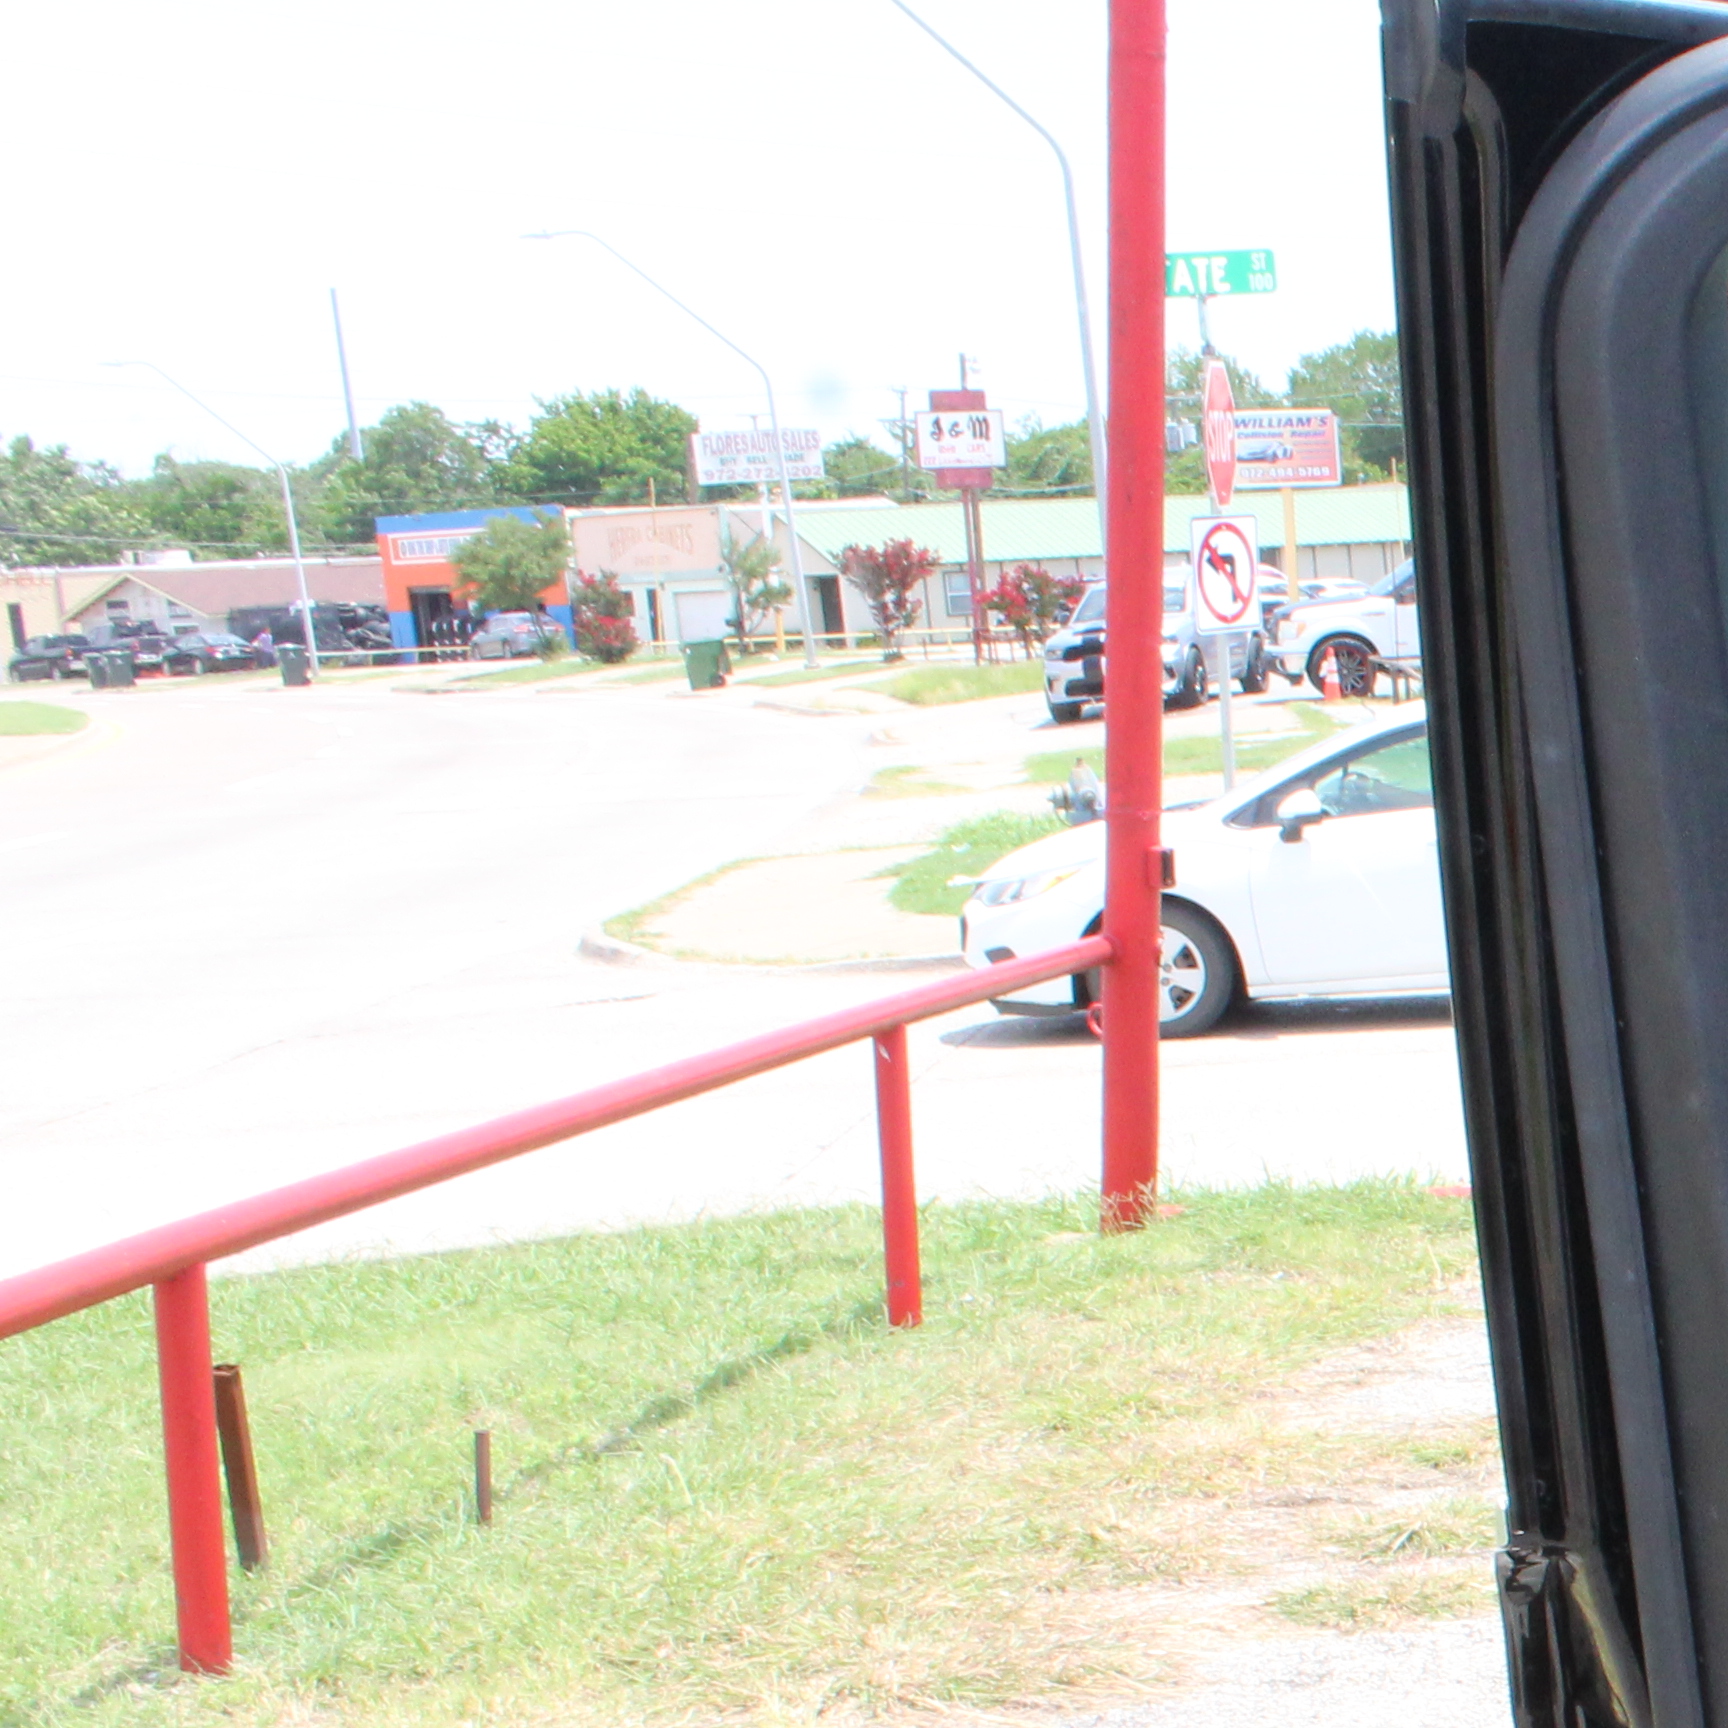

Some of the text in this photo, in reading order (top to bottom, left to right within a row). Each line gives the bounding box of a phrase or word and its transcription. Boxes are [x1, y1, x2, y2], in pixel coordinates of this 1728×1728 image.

[1165, 252, 1266, 294] ATE ST
[1248, 273, 1274, 292] 100
[1235, 415, 1328, 429] WILLIAM'S
[702, 433, 749, 456] FLORES
[781, 429, 820, 451] SALES
[1206, 410, 1233, 462] STOP
